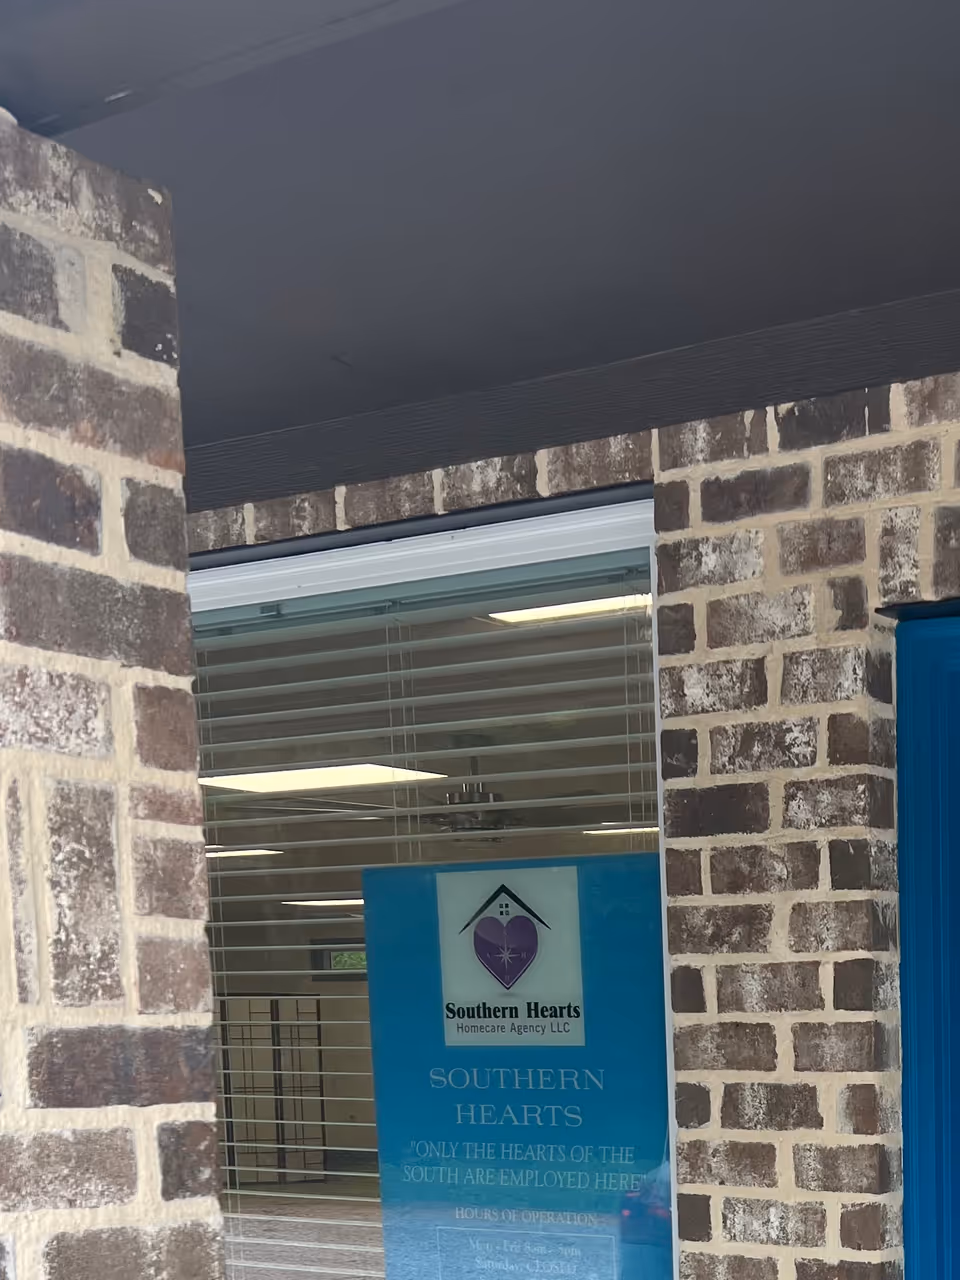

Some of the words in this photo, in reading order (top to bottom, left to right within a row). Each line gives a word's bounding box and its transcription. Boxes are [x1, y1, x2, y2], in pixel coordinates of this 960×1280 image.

[445, 1002, 519, 1019] Southern
[526, 1002, 581, 1019] Hearts
[456, 1022, 506, 1034] Homecare
[510, 1022, 546, 1035] Agency
[550, 1022, 571, 1033] LLC
[429, 1067, 605, 1090] SOUTHERN
[455, 1104, 583, 1128] HEARTS
[410, 1140, 460, 1159] "ONLY
[462, 1142, 496, 1160] THE
[500, 1143, 566, 1162] HEARTS
[570, 1145, 593, 1163] OF
[599, 1146, 635, 1164] THE
[403, 1165, 458, 1184] SOUTH
[463, 1167, 495, 1185] ARE
[499, 1169, 590, 1190] EMPLOYED
[595, 1173, 647, 1192] HERE"
[455, 1206, 499, 1222] HOURS
[501, 1208, 520, 1223] OF
[521, 1209, 598, 1226] OPERATION
